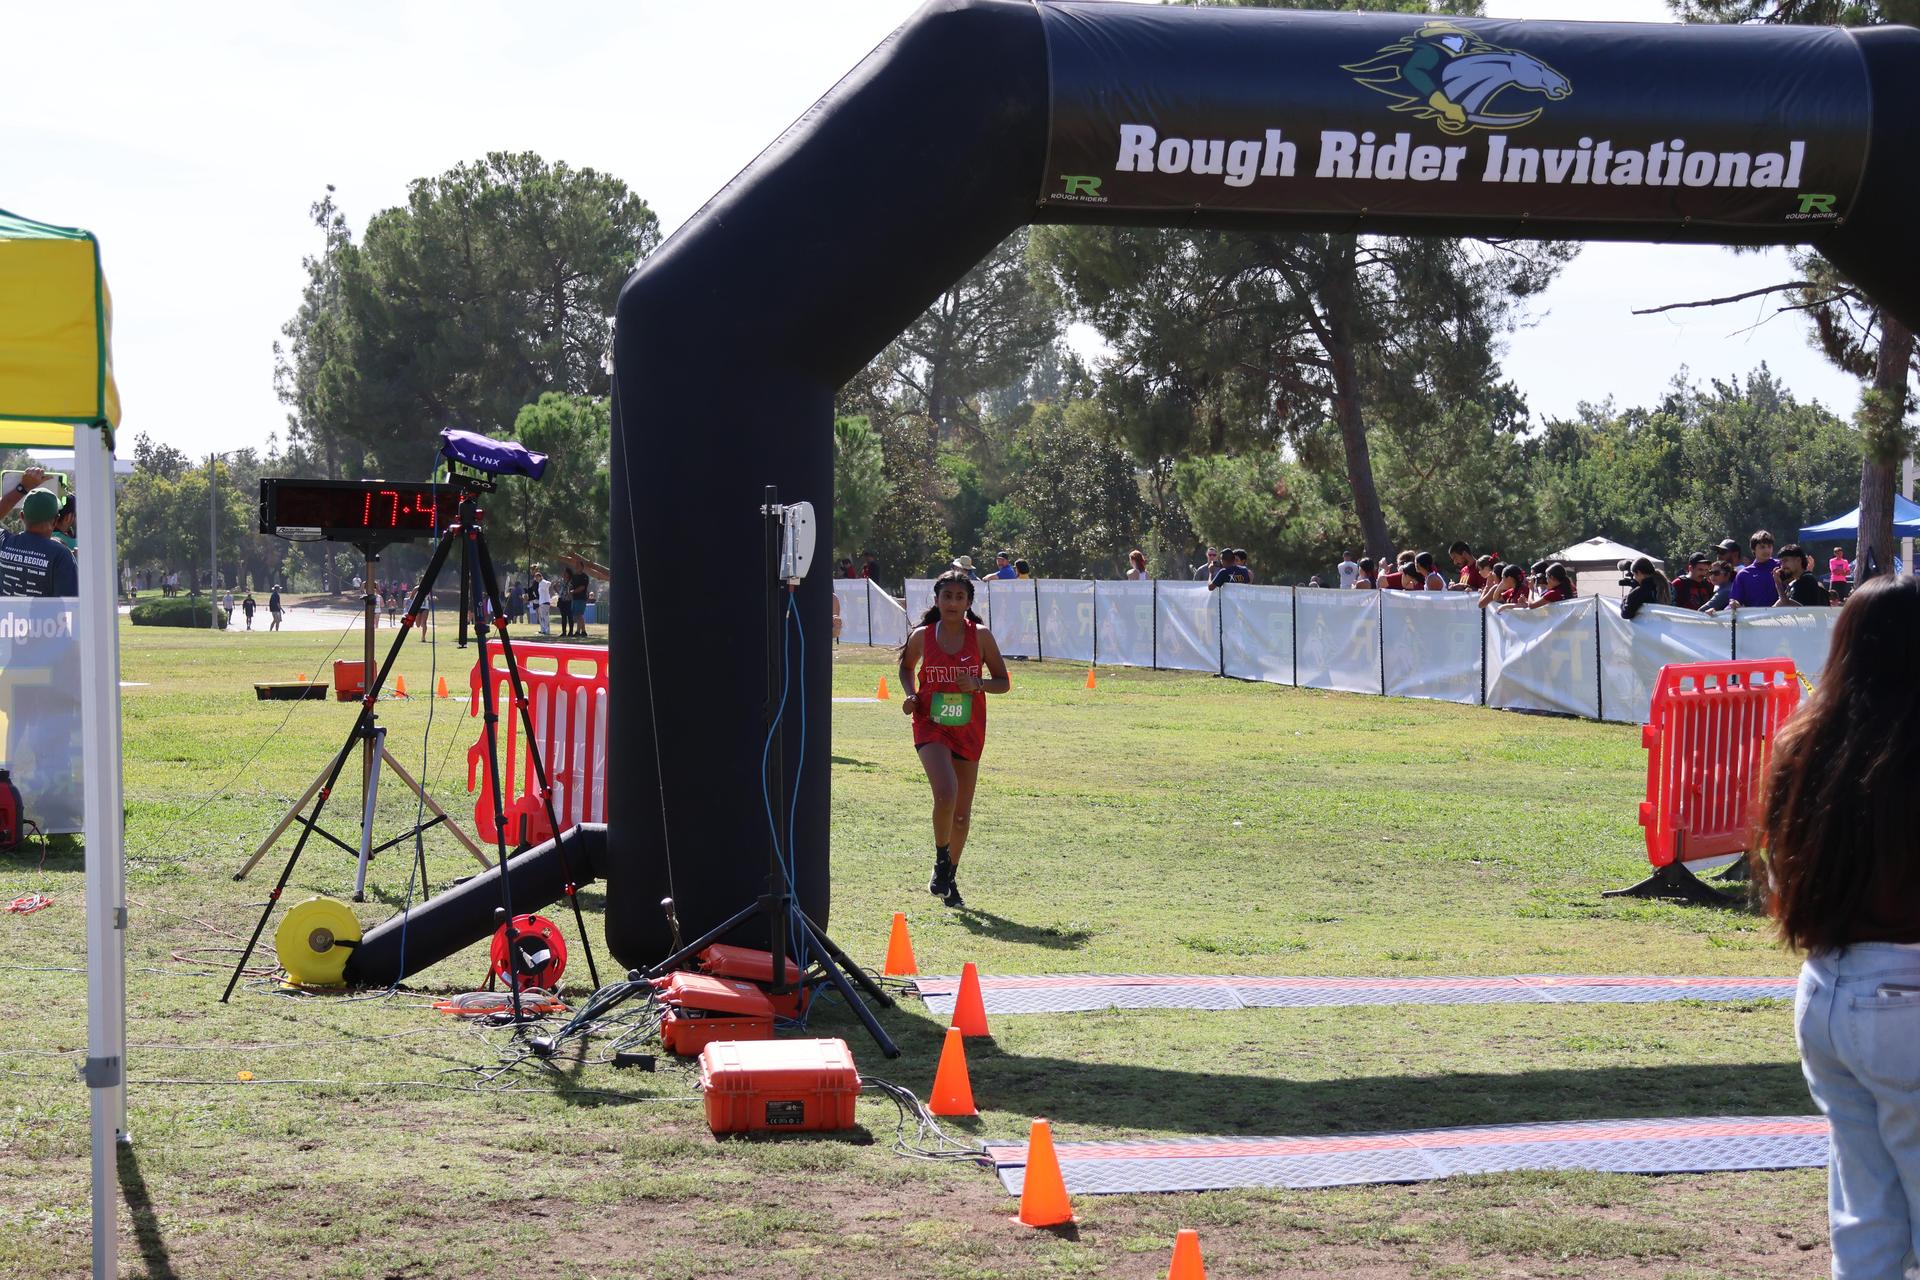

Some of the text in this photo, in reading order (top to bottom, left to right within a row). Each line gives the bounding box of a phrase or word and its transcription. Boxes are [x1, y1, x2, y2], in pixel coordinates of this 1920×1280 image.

[1115, 124, 1806, 188] Rough Rider Invitational
[472, 454, 500, 466] LYNX
[23, 555, 49, 568] REGION
[941, 704, 963, 717] 298
